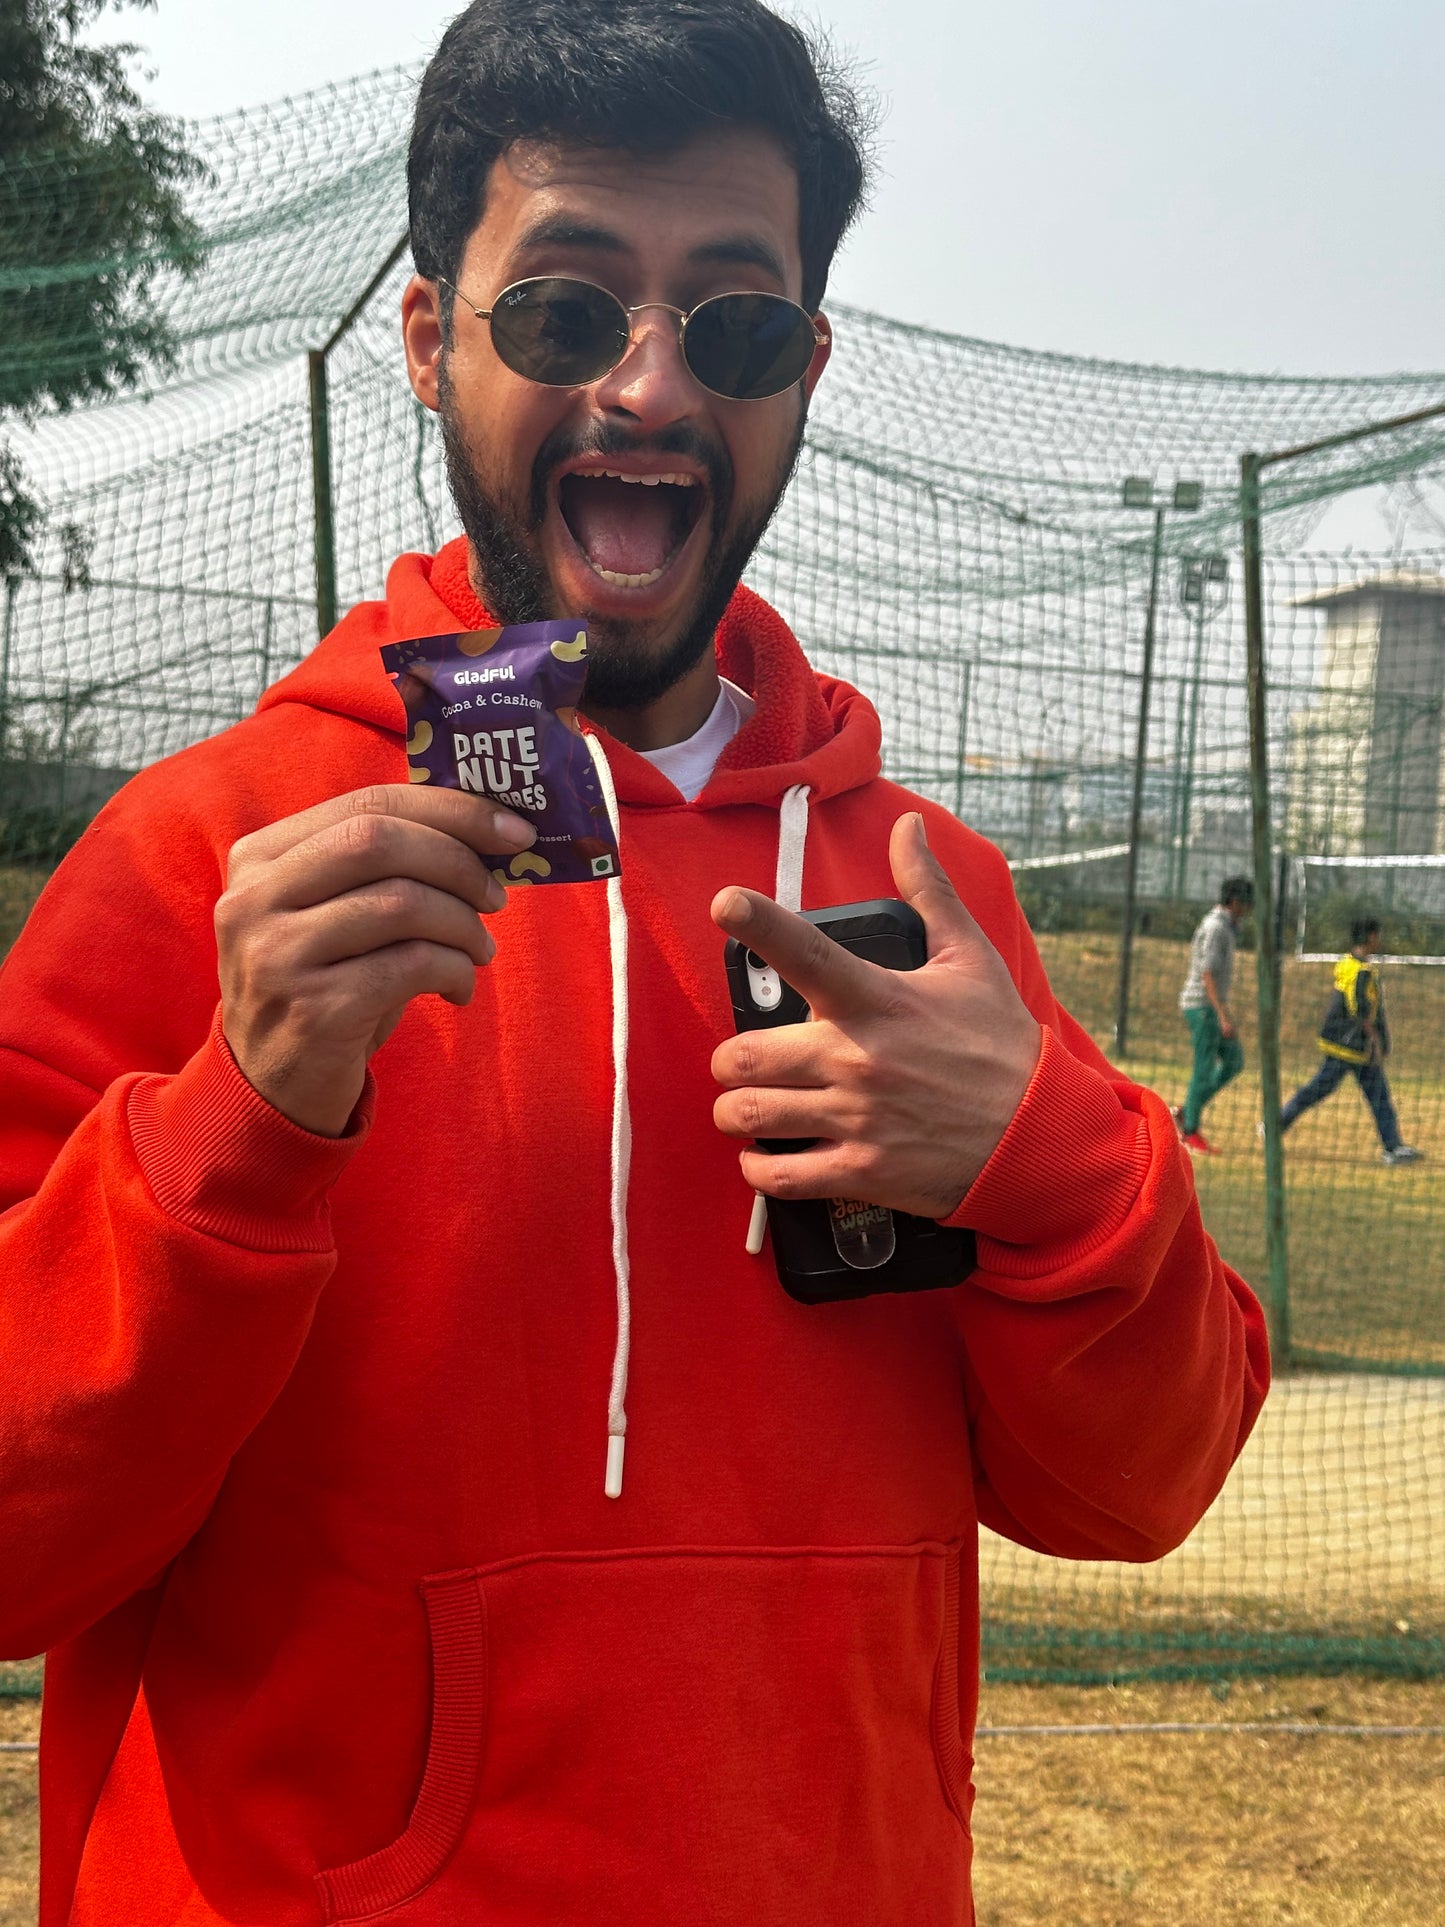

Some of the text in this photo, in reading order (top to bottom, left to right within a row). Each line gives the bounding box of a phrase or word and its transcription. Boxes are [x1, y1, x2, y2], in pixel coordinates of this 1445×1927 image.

[441, 692, 543, 718] Cocoa & Cashew
[453, 726, 539, 763] DATE
[457, 757, 540, 793] NUT
[537, 834, 572, 842] essert
